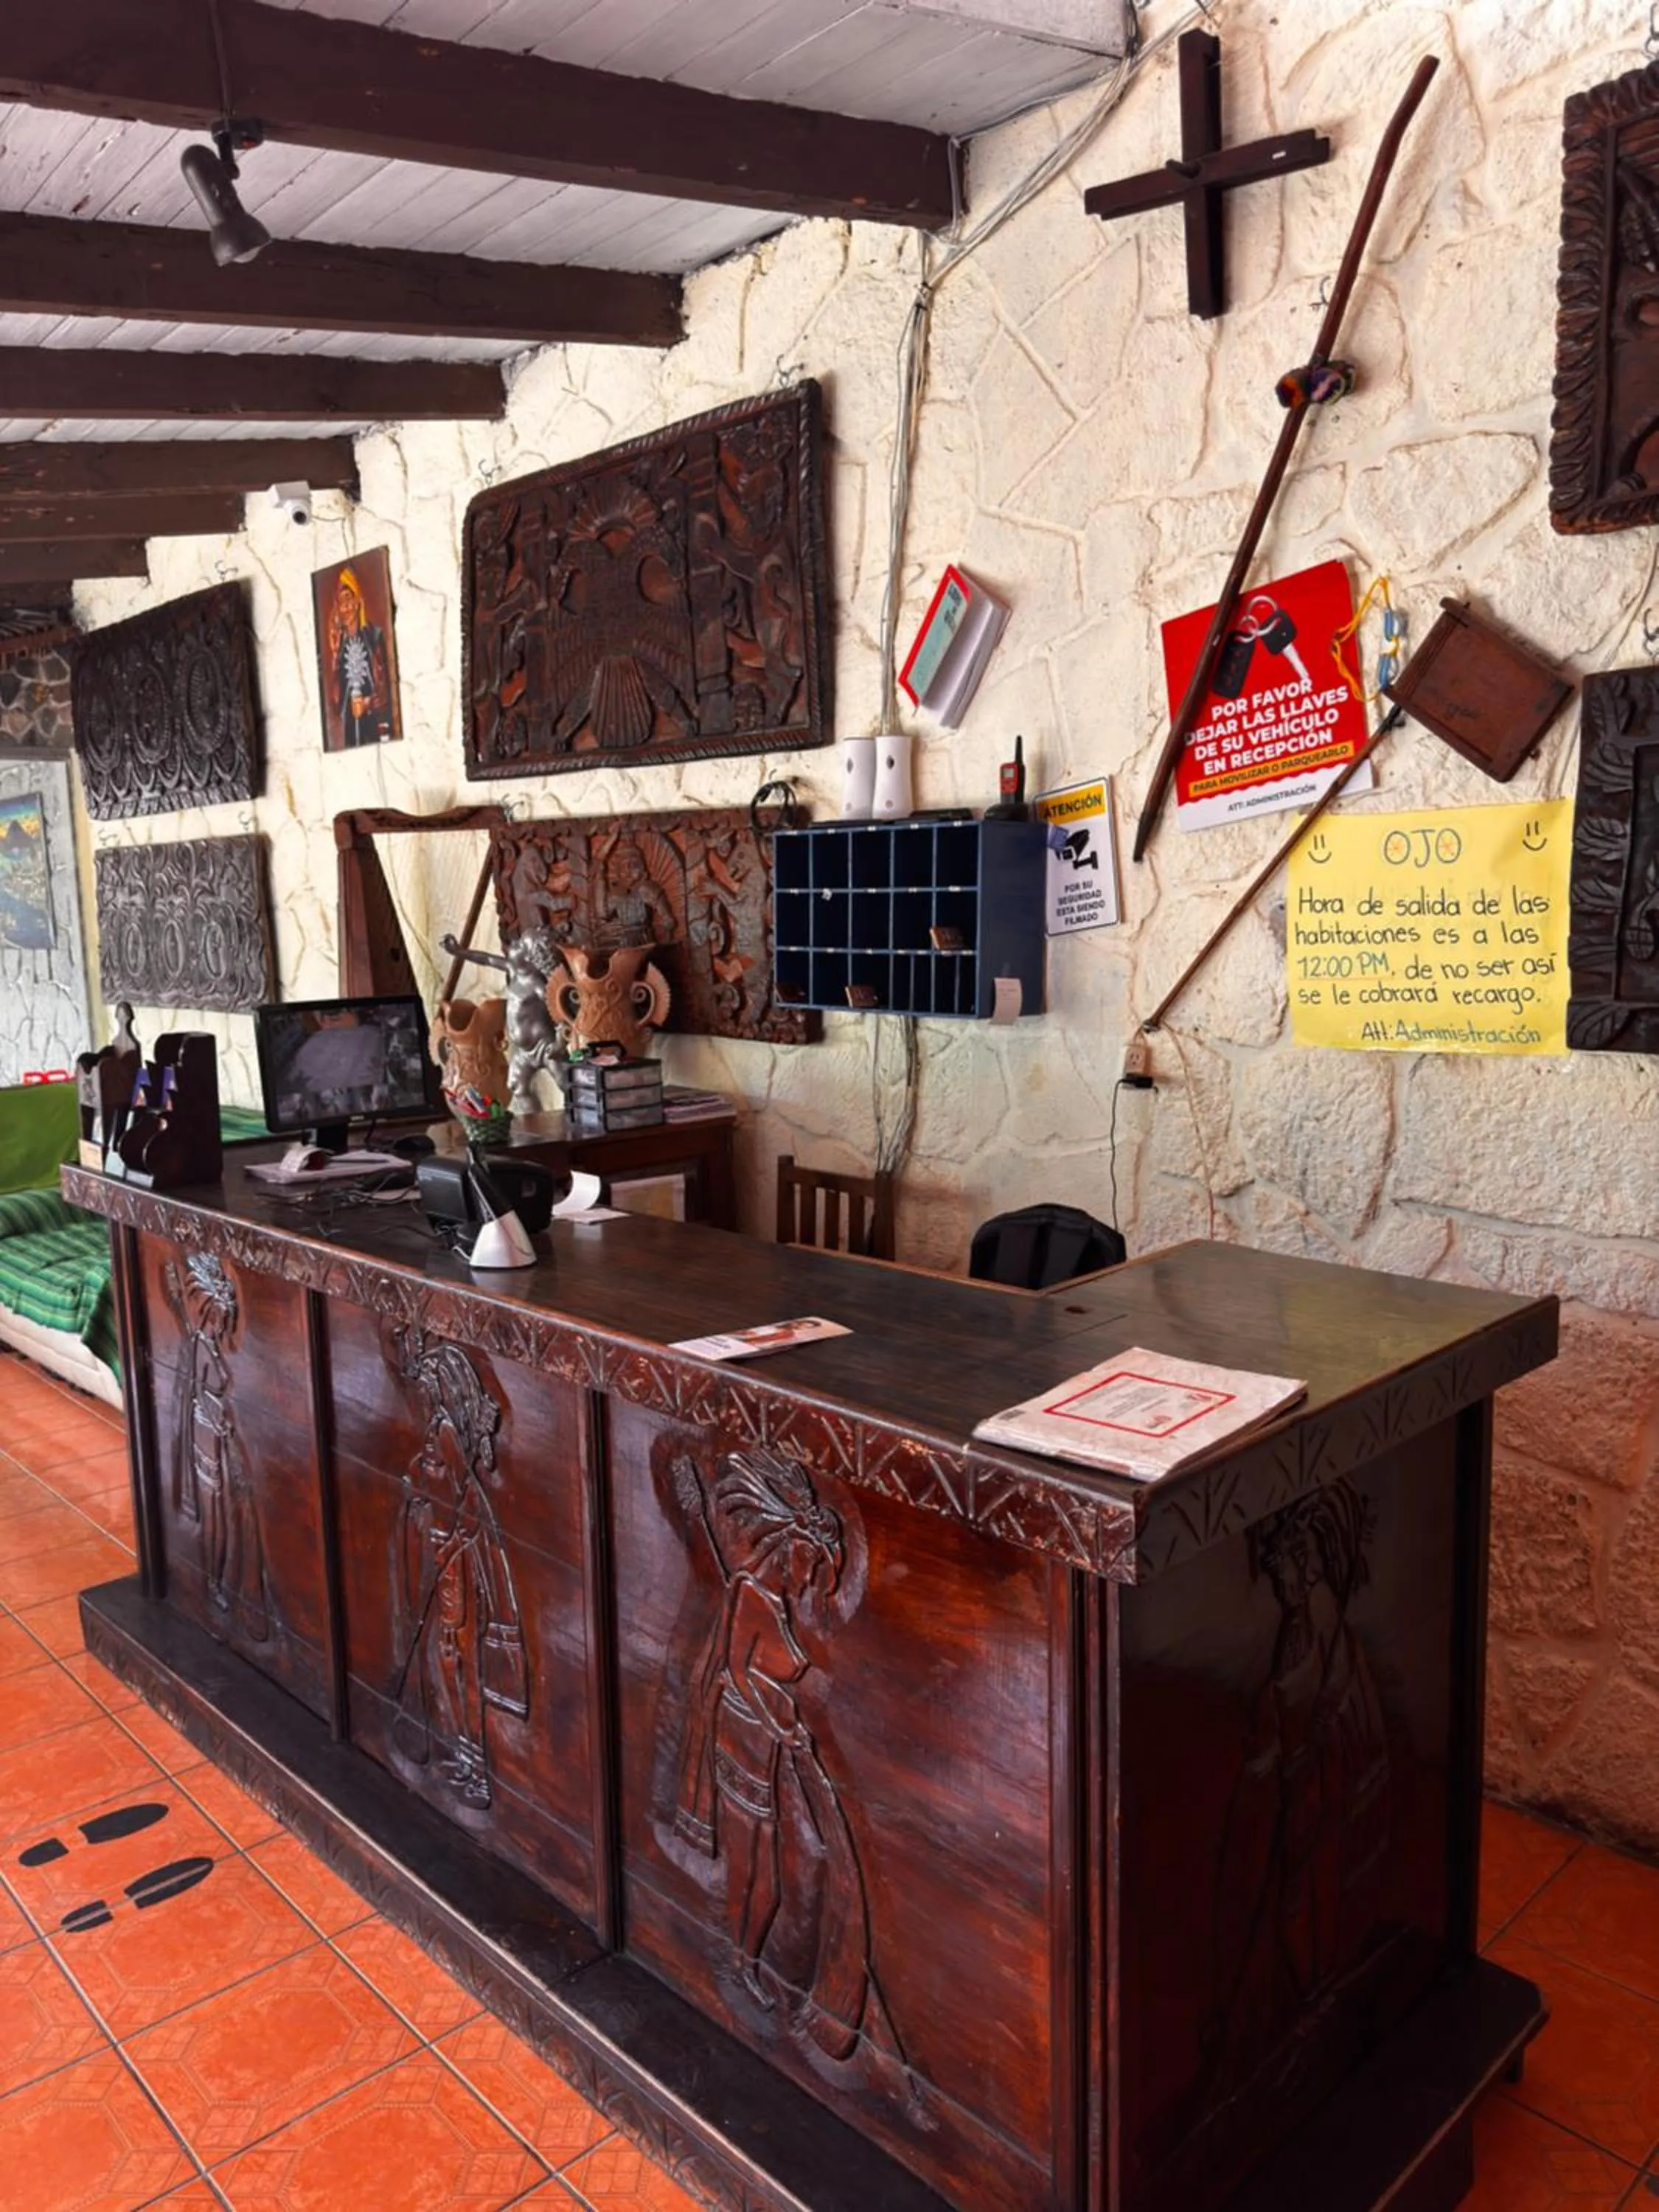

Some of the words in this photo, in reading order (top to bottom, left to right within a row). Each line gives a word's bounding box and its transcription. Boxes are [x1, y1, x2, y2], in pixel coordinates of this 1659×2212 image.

[1184, 719, 1238, 745] DEJAR
[1242, 708, 1276, 730] LAS
[1280, 686, 1349, 719] LLAVES
[1211, 698, 1248, 720] POR
[1252, 678, 1312, 709] FAVOR
[1194, 744, 1217, 760] DE
[1221, 734, 1244, 754] SU
[1248, 709, 1339, 744] VEHÍCULO
[1203, 757, 1226, 775] EN
[1231, 728, 1333, 768] RECEPCIÓN
[1192, 780, 1218, 792] PARA
[1219, 765, 1270, 789] MOVILIZAR
[1272, 764, 1280, 773] O
[1282, 745, 1349, 771] PARQUEARLO
[1043, 793, 1102, 819] ATENCIÓN
[1247, 784, 1316, 807] ADMINISTRACIÓN
[1383, 827, 1461, 868] OJO
[1298, 886, 1344, 914] Hora
[1357, 886, 1384, 916] de
[1396, 885, 1461, 916] salida
[1472, 888, 1500, 915] de
[1512, 884, 1550, 914] las
[1295, 920, 1421, 945] habitaciones
[1433, 926, 1460, 945] es
[1472, 929, 1488, 945] a
[1501, 920, 1540, 945] las
[1298, 956, 1353, 978] 12:00
[1405, 954, 1433, 980] de
[1441, 963, 1470, 979] no
[1477, 960, 1515, 975] ser
[1521, 952, 1557, 975] así
[1298, 988, 1321, 1005] se
[1332, 984, 1351, 1005] le
[1359, 981, 1439, 1004] cobrará
[1453, 987, 1543, 1015] recargo.
